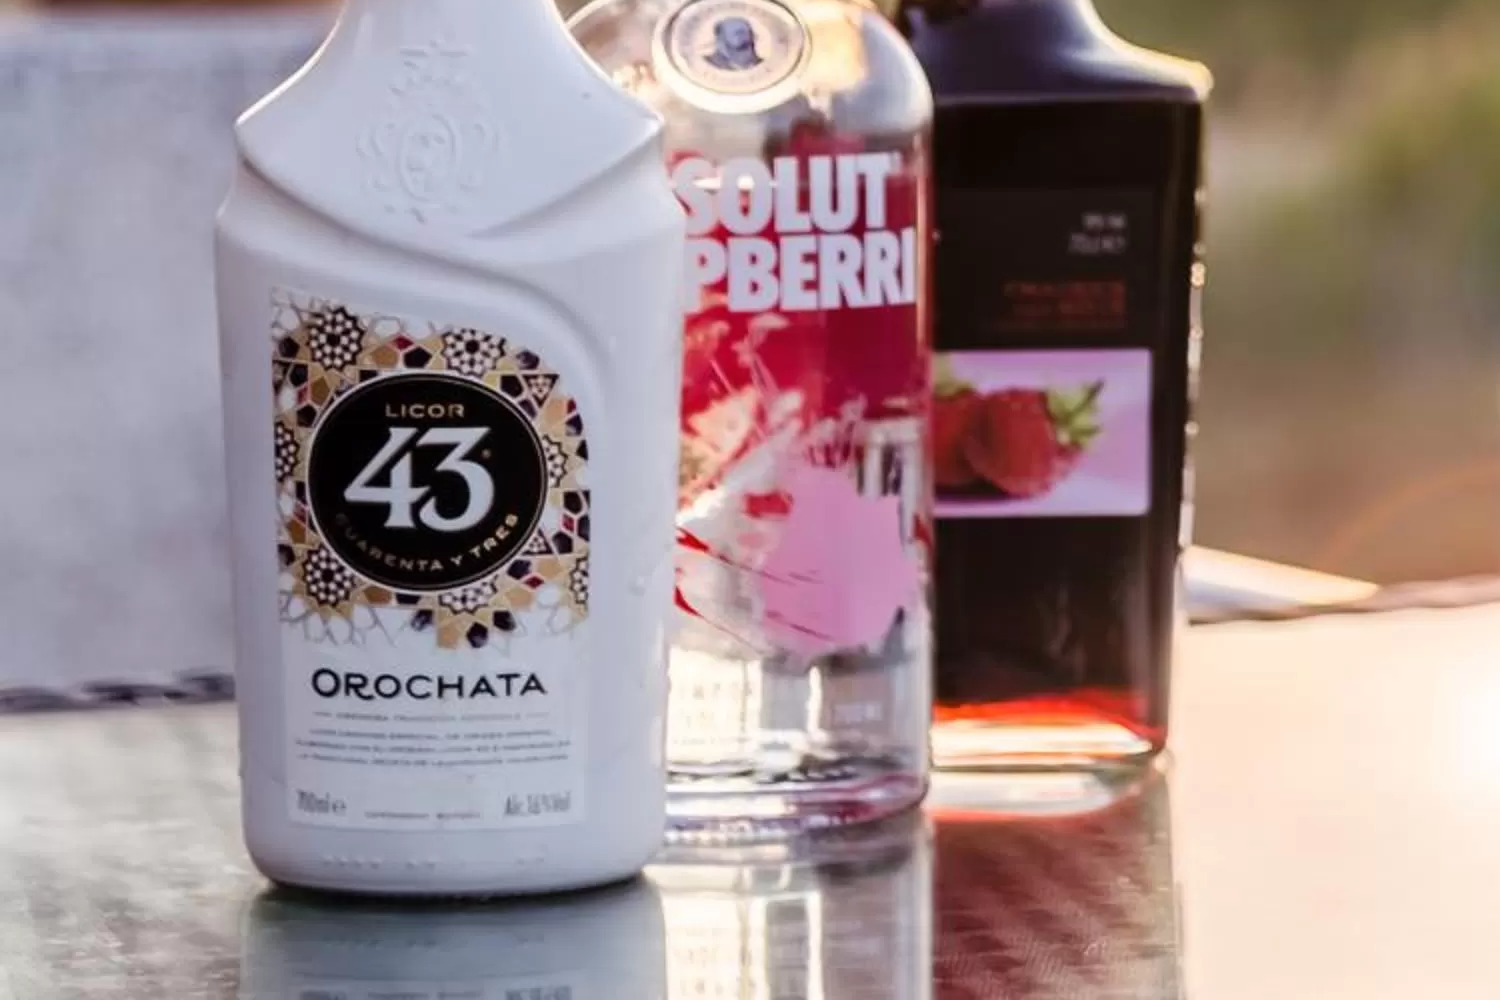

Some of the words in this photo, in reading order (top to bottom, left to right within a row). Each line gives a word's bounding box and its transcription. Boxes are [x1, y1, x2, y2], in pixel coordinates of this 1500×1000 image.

[385, 402, 466, 419] LICOR
[343, 426, 496, 533] 43
[450, 554, 465, 567] Y
[469, 512, 519, 559] TRES
[311, 667, 548, 701] OROCHATA
